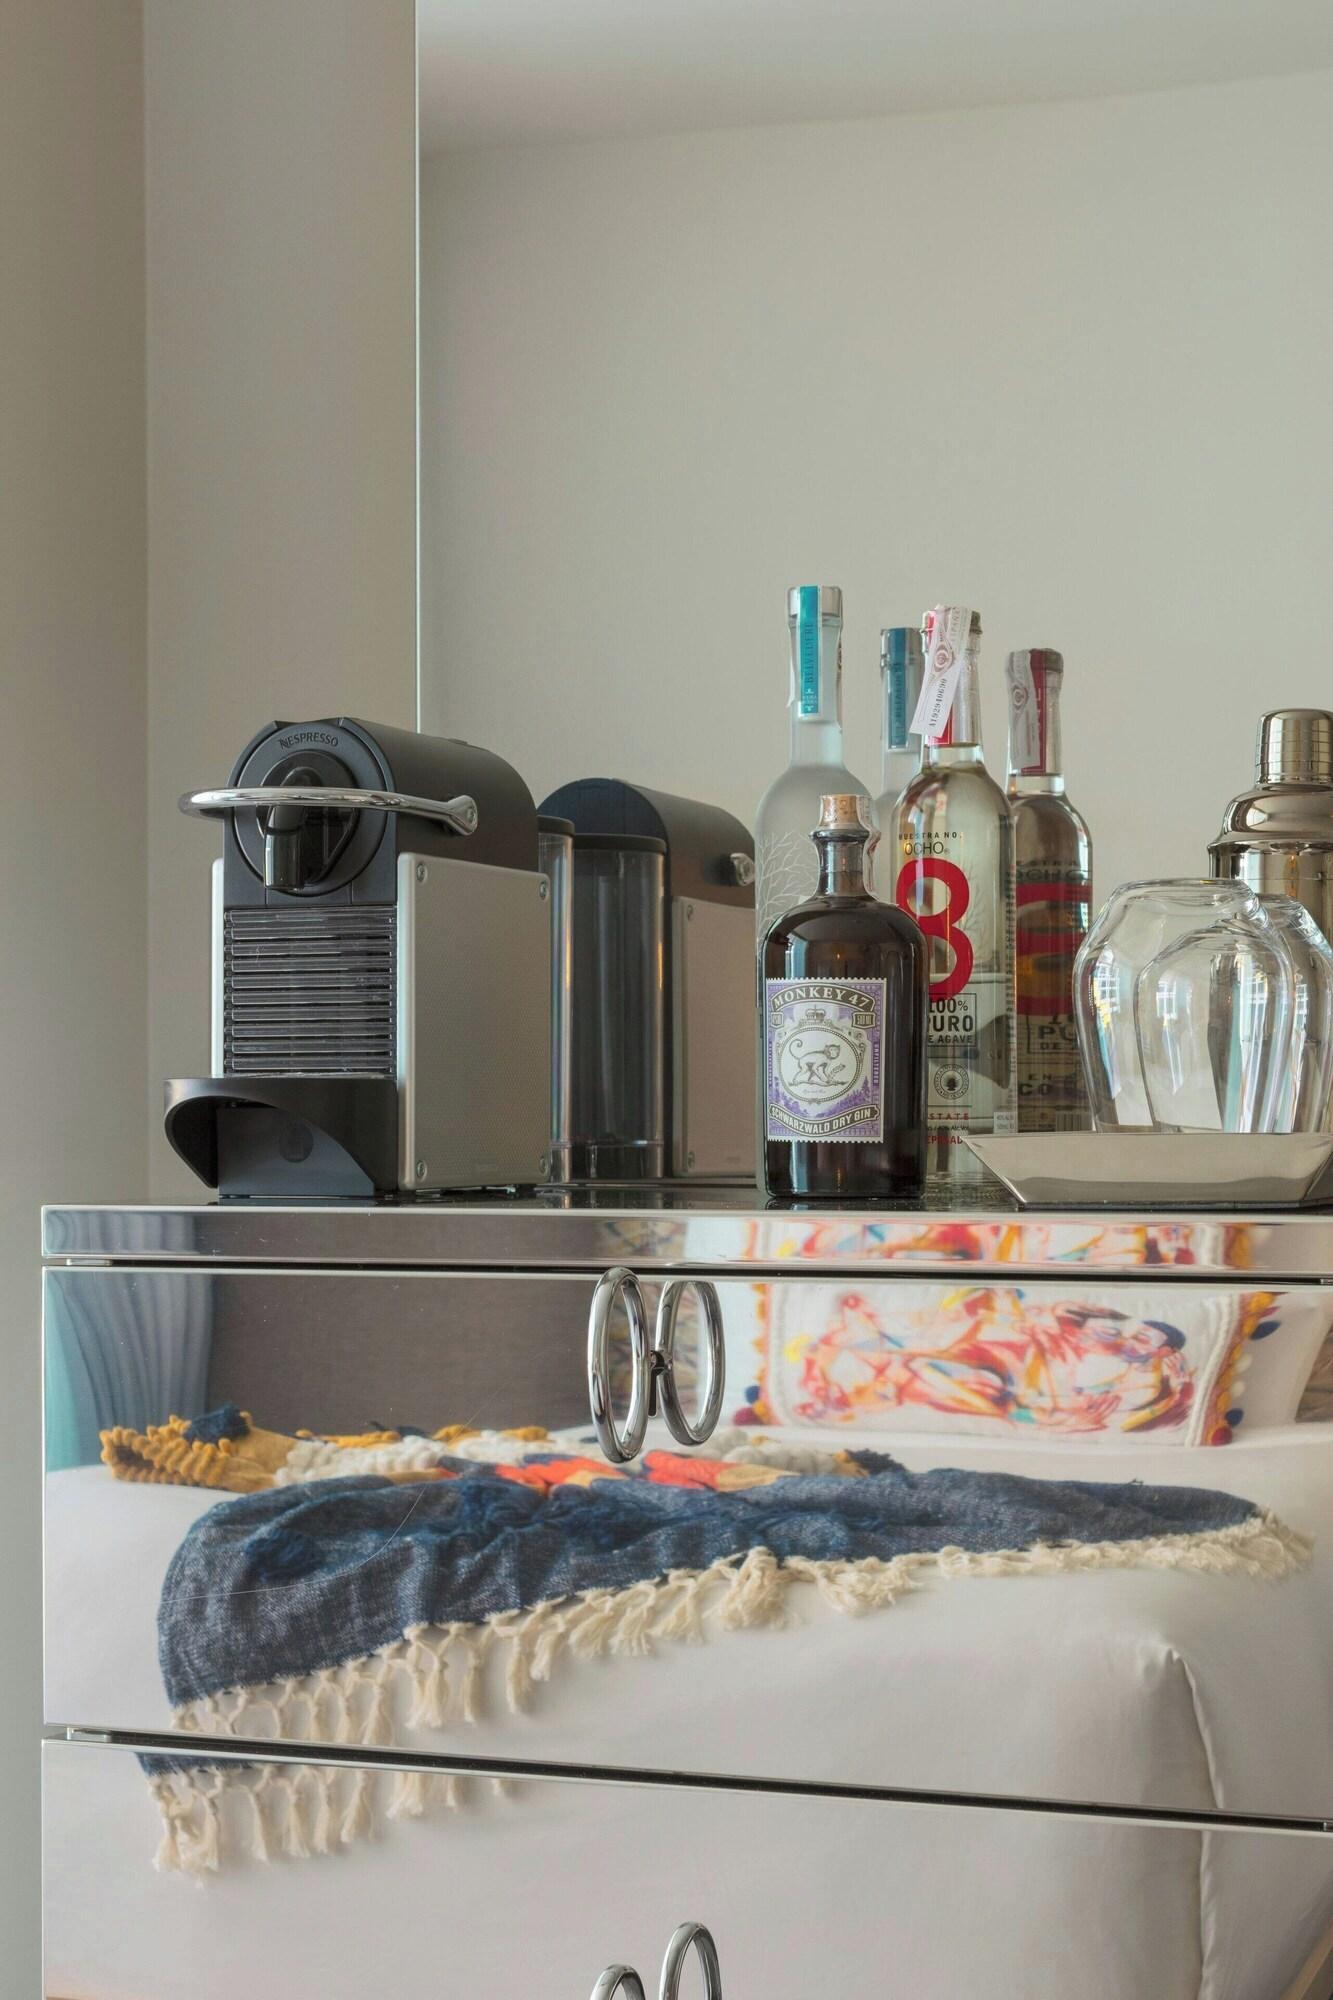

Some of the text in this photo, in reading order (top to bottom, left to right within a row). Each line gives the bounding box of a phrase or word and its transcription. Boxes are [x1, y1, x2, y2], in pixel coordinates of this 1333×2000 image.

[278, 732, 339, 750] NESPRESSO
[904, 841, 944, 856] OCHO
[896, 857, 974, 1003] 8
[774, 986, 871, 1009] MONKEY 47
[928, 997, 969, 1013] 100%
[927, 1015, 974, 1032] URO
[937, 1034, 973, 1044] AGAVE
[771, 1106, 871, 1134] SCHWARZWALD DRY GIN
[928, 1112, 969, 1121] STATE
